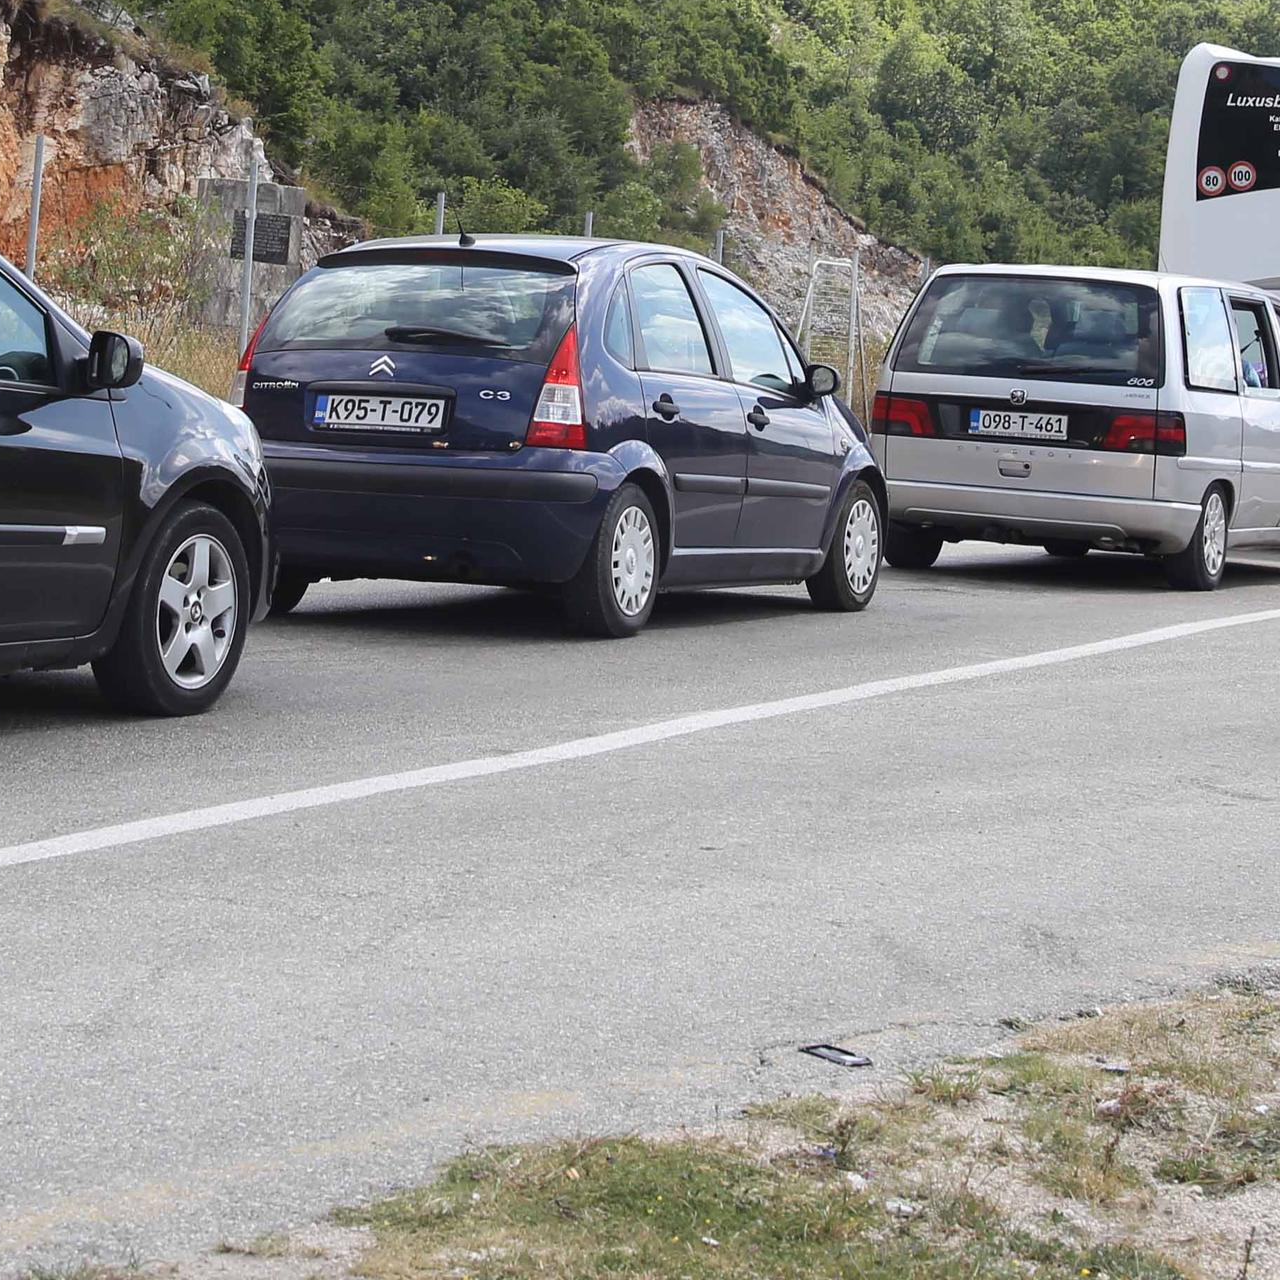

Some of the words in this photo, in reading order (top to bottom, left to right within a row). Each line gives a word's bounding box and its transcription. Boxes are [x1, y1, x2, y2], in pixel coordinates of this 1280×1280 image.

[1205, 176, 1219, 186] 80
[1233, 170, 1251, 181] 100
[1127, 377, 1155, 387] 806
[479, 389, 511, 401] C3
[329, 398, 440, 425] K95-T-079
[982, 413, 1064, 434] 098-T-461
